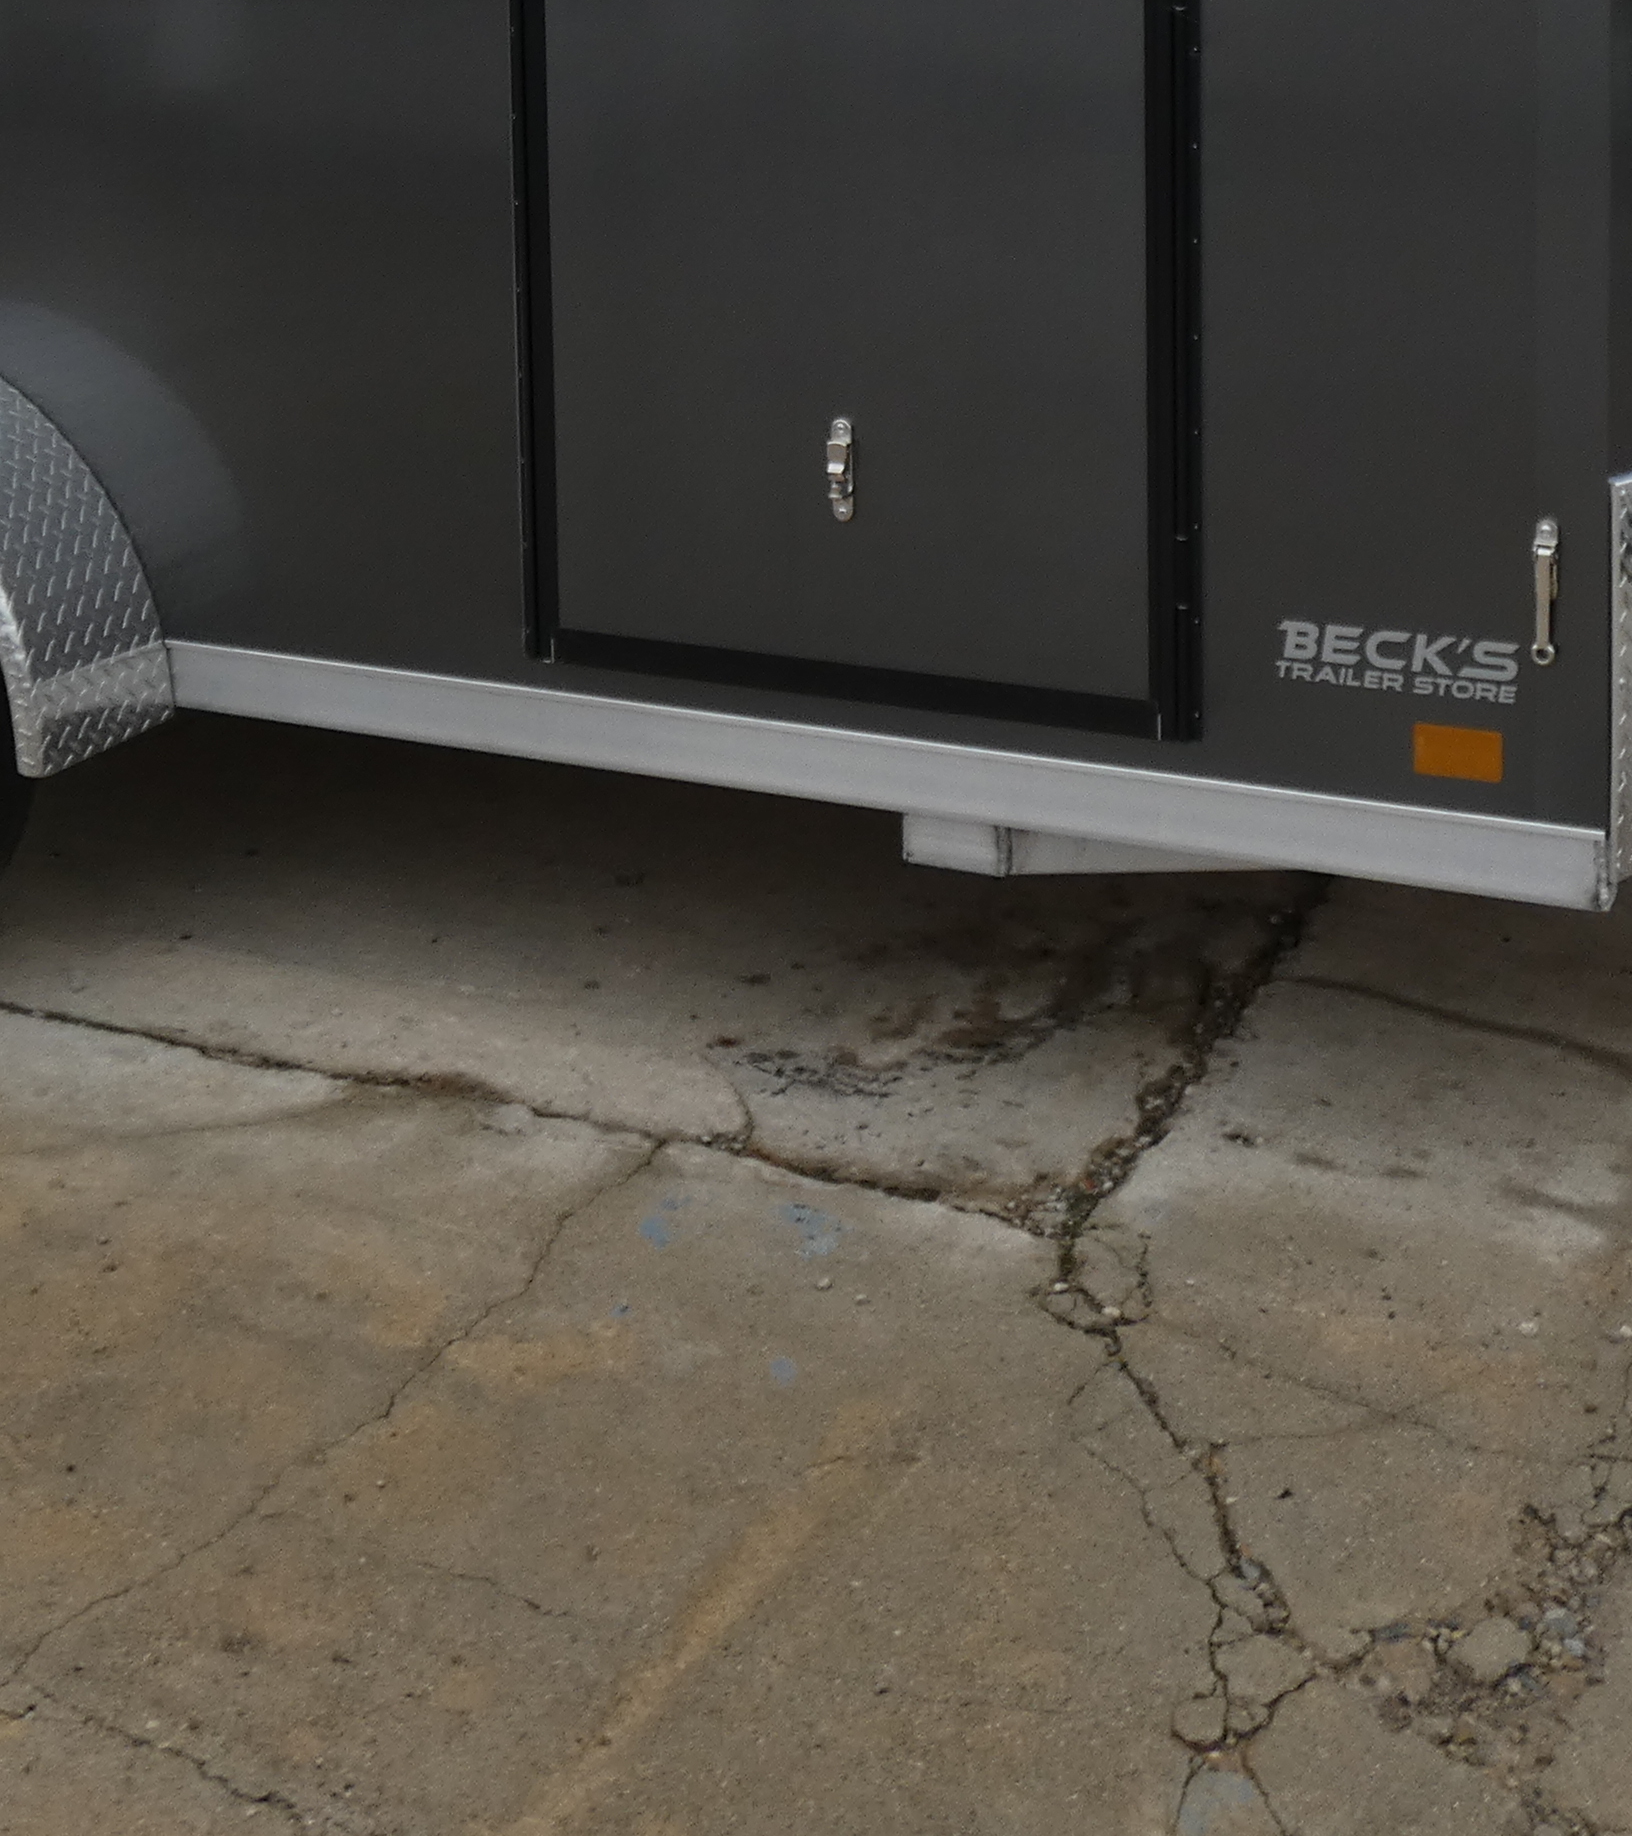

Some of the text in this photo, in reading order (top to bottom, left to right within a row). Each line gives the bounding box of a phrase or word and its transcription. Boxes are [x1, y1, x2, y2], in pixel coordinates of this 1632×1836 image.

[1277, 619, 1520, 682] BECK'S
[1275, 660, 1517, 705] TRAILER STORE
